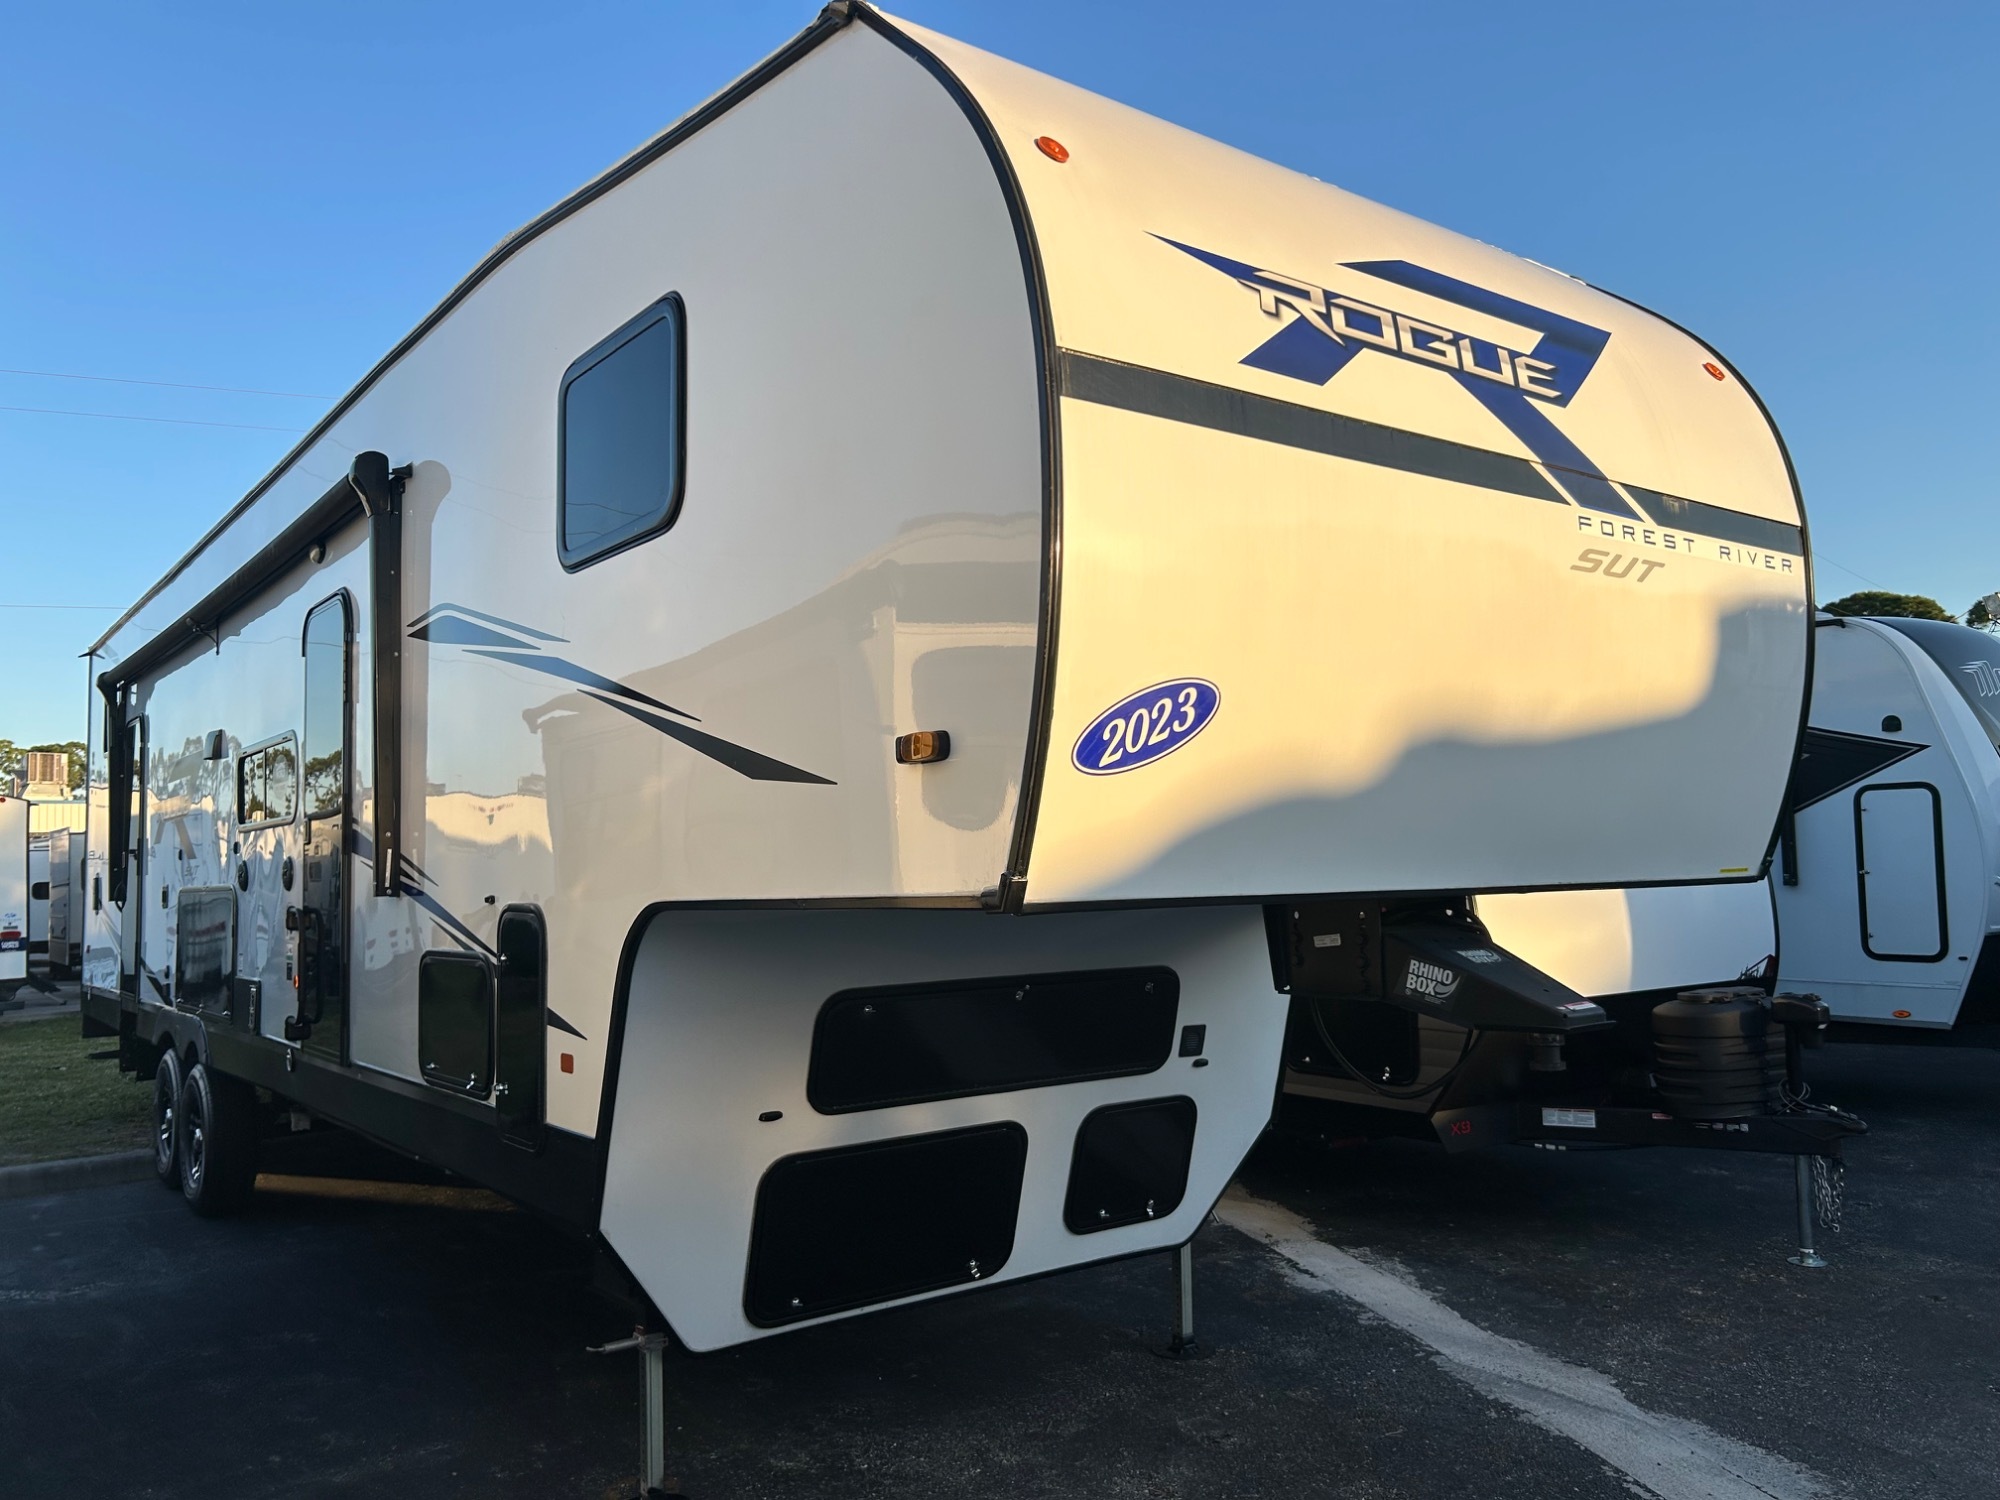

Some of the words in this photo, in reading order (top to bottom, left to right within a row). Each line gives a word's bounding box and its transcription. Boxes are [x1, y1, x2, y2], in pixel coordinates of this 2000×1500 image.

[1236, 270, 1562, 398] ROGUE
[1570, 548, 1666, 583] SUT
[1577, 515, 1695, 553] FOREST
[1719, 545, 1793, 573] RIVER
[1098, 687, 1198, 768] 2023
[1406, 973, 1436, 996] BOX
[1408, 959, 1453, 984] RHINO
